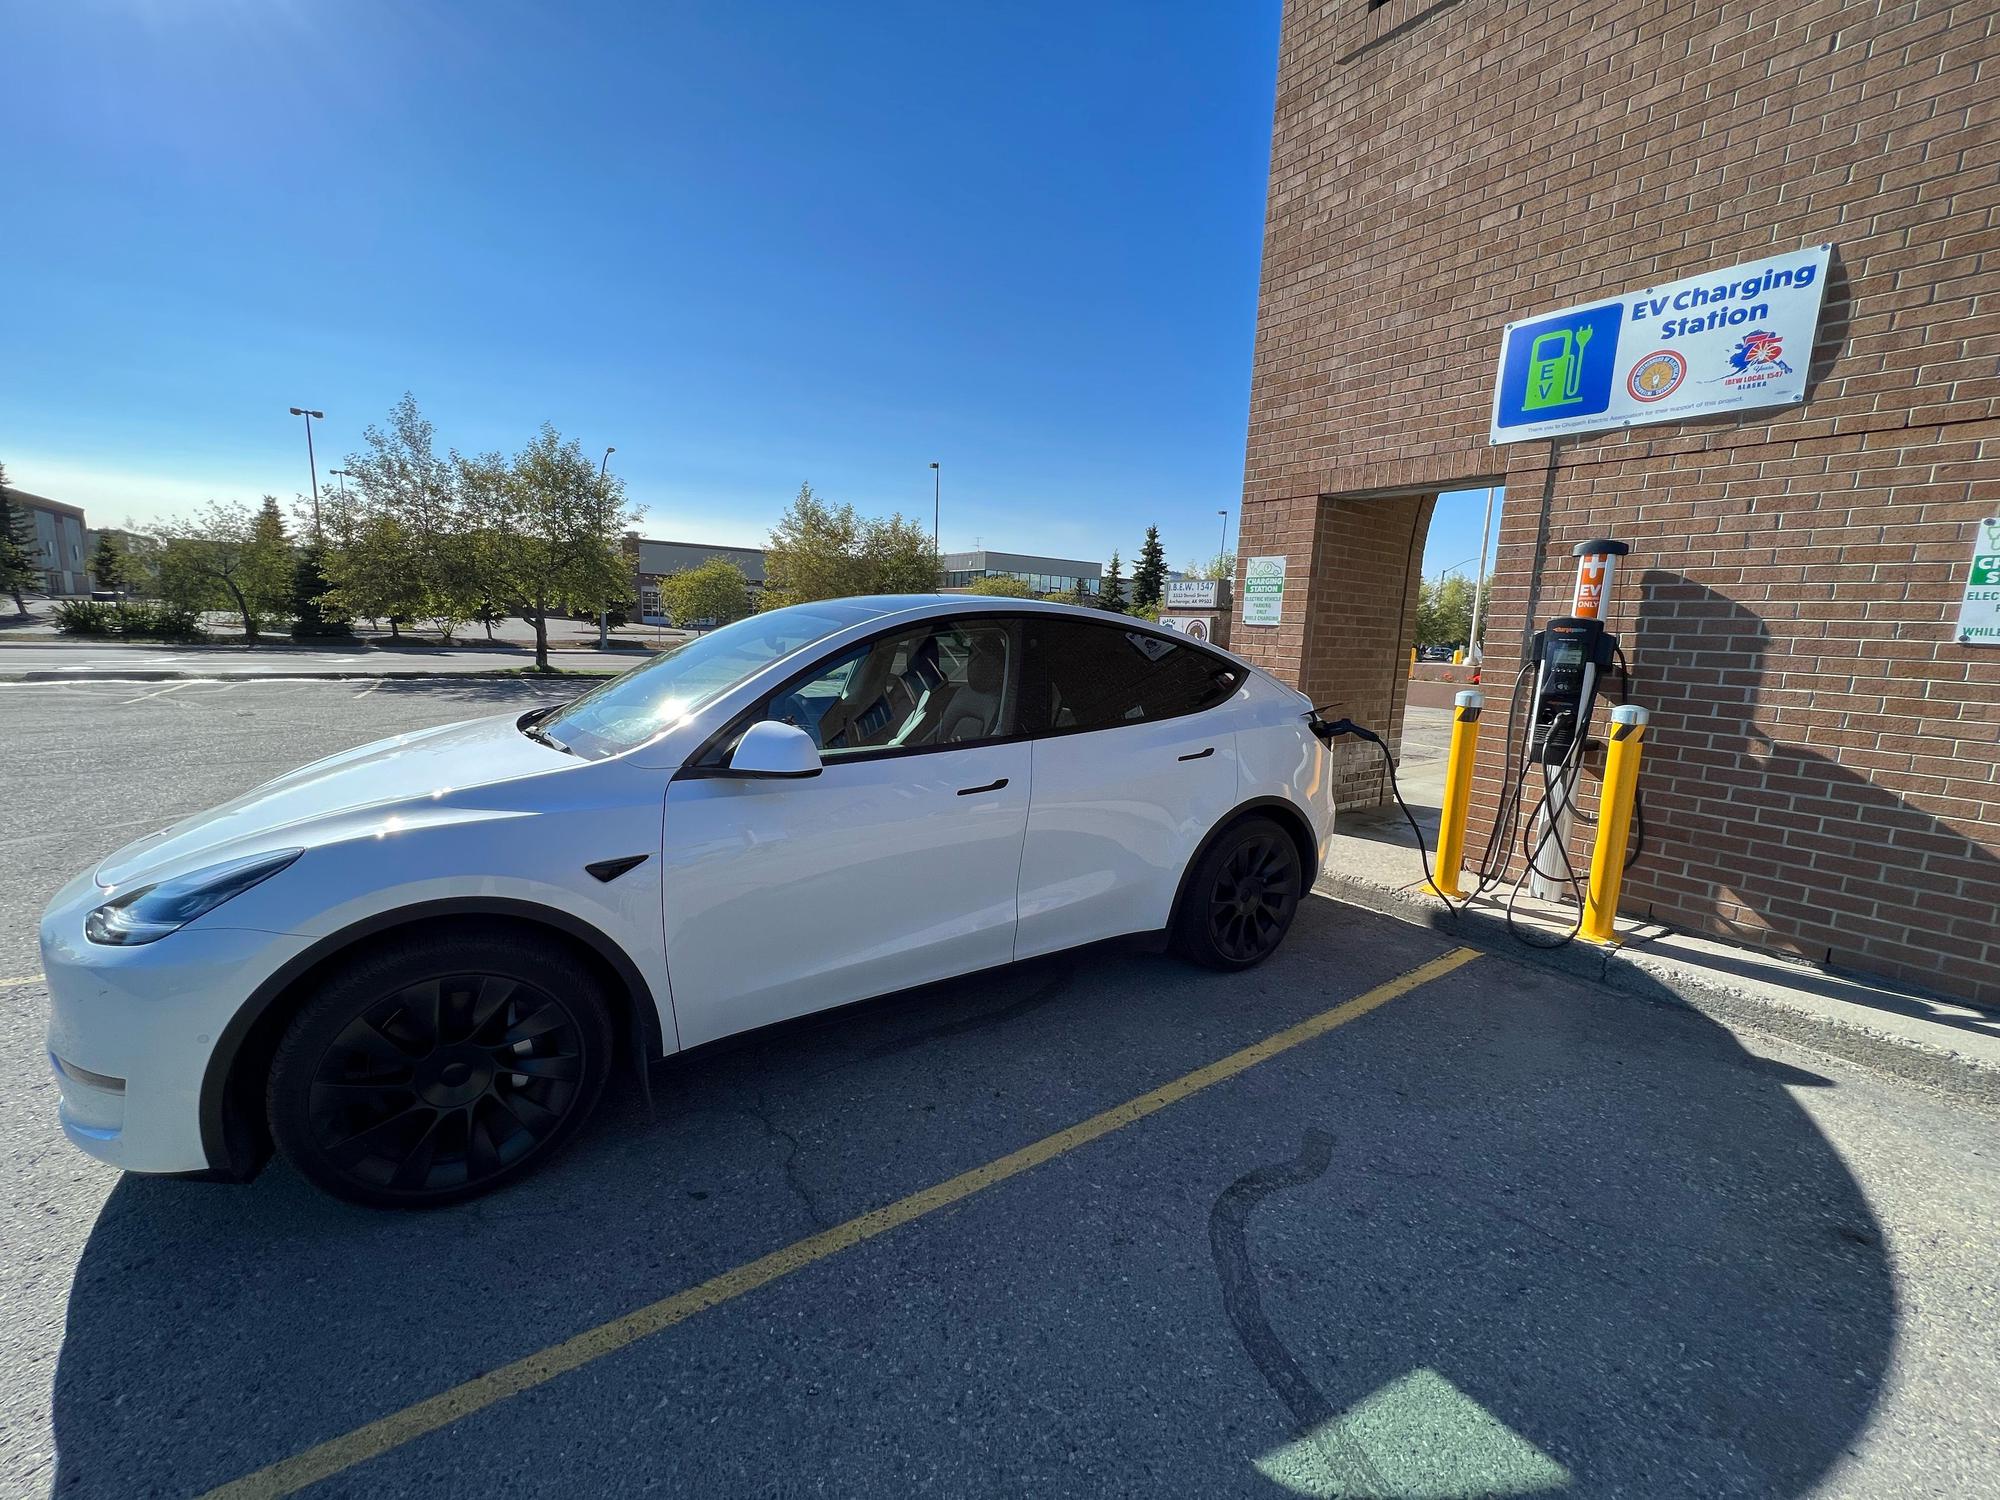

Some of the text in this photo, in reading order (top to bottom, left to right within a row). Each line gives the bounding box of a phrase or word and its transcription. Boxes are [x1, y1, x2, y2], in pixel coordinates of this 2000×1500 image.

[1632, 264, 1817, 321] EV Charging
[1660, 303, 1768, 339] Station
[1743, 375, 1765, 383] LOCAL
[1737, 381, 1767, 390] ALASKA
[1197, 582, 1214, 591] 1547
[1579, 584, 1602, 596] EV
